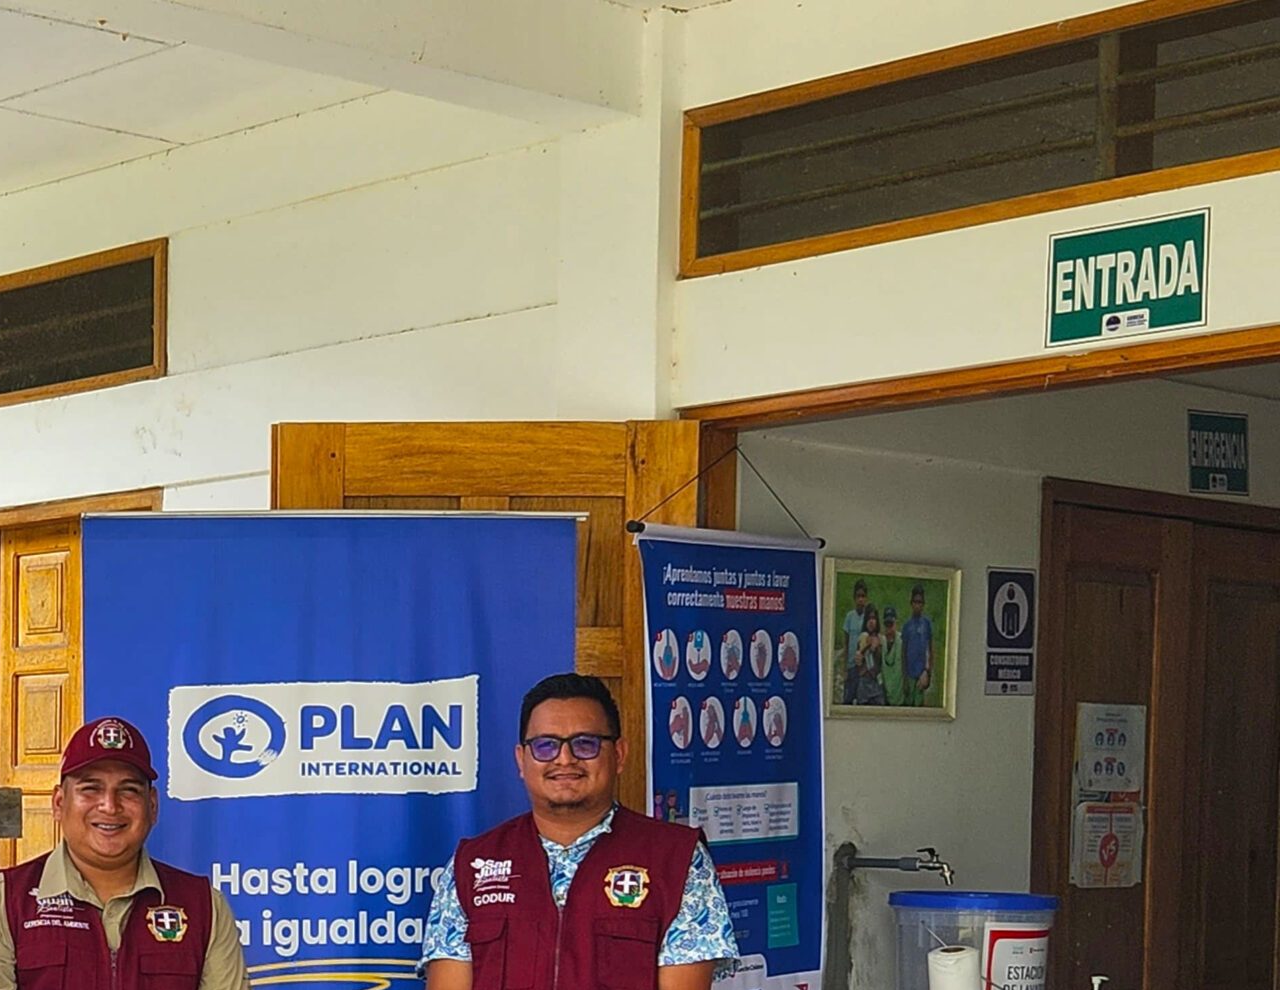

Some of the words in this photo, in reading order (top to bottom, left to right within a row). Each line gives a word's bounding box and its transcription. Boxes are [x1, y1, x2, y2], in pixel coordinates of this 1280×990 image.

[1055, 239, 1199, 314] ENTRADA
[300, 704, 463, 750] PLAN
[301, 761, 461, 776] INTERNATIONAL
[474, 866, 511, 879] Juan
[485, 859, 512, 868] San
[212, 862, 337, 895] Hasta
[474, 893, 515, 906] GODUR
[262, 909, 423, 957] igualda
